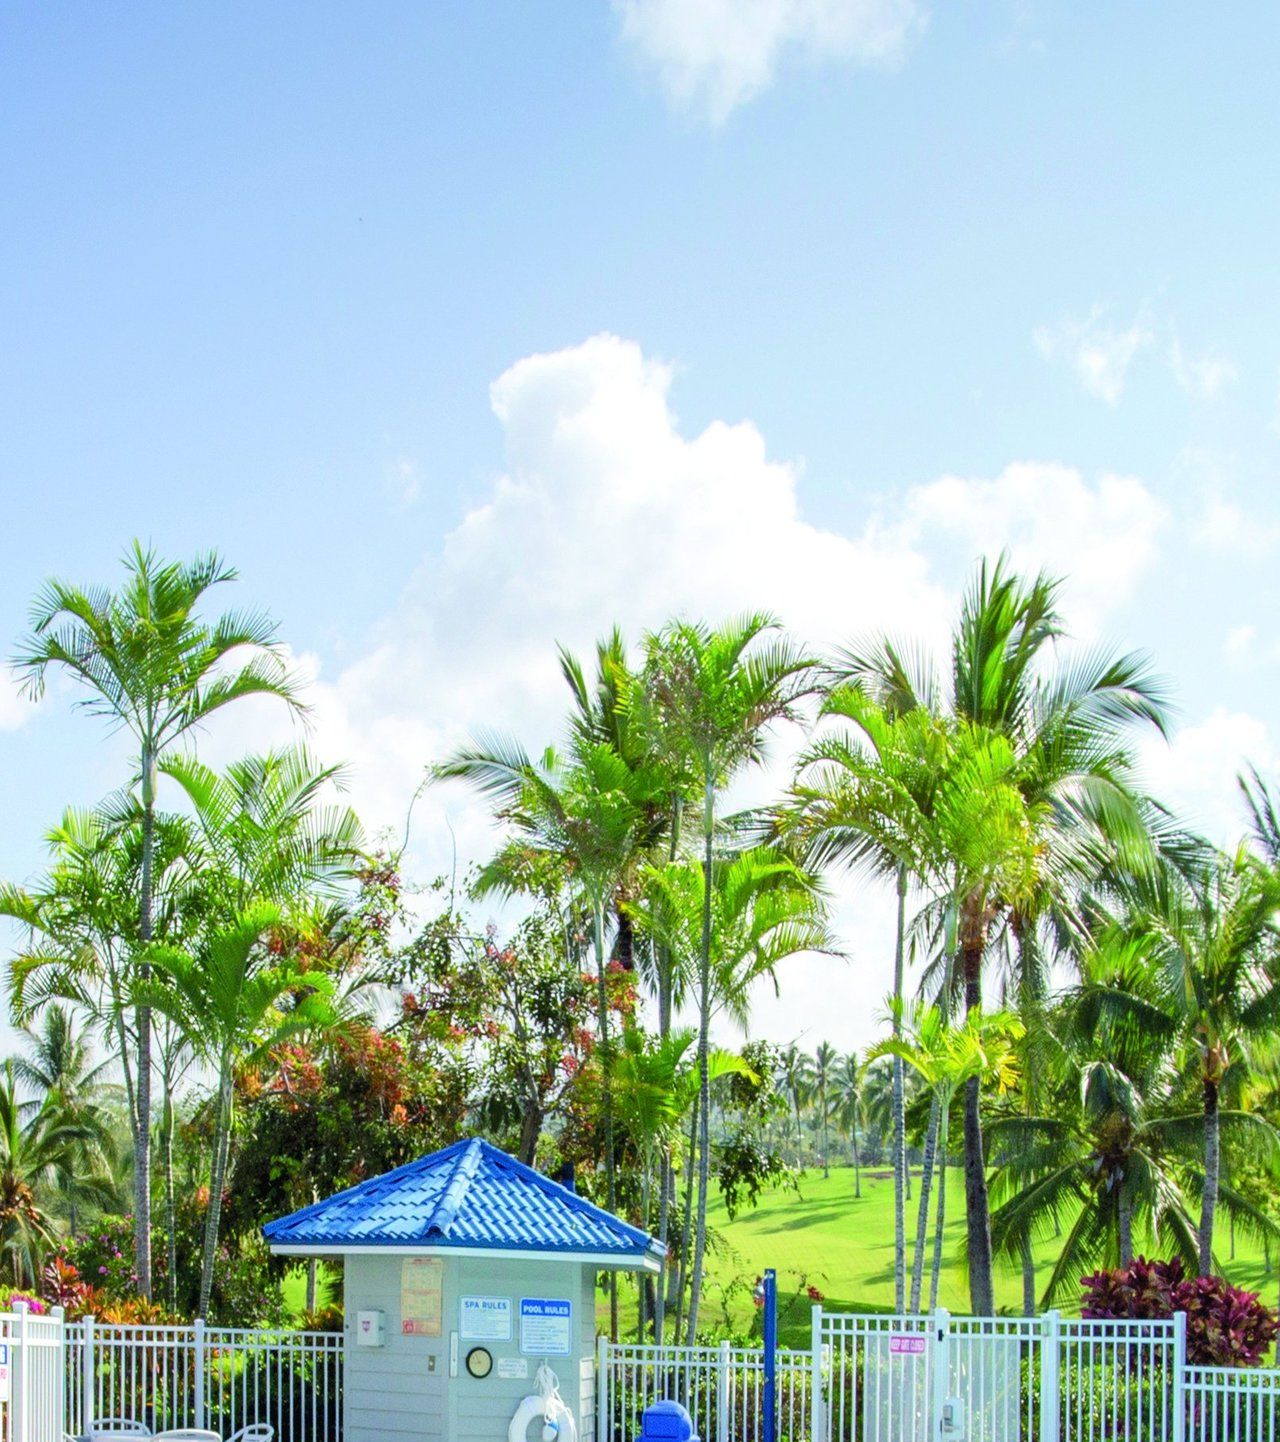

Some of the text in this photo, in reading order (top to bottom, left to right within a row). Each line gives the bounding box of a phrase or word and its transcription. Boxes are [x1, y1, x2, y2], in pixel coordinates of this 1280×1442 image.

[464, 1301, 507, 1310] SPA RULES
[523, 1305, 569, 1315] POOL RULES
